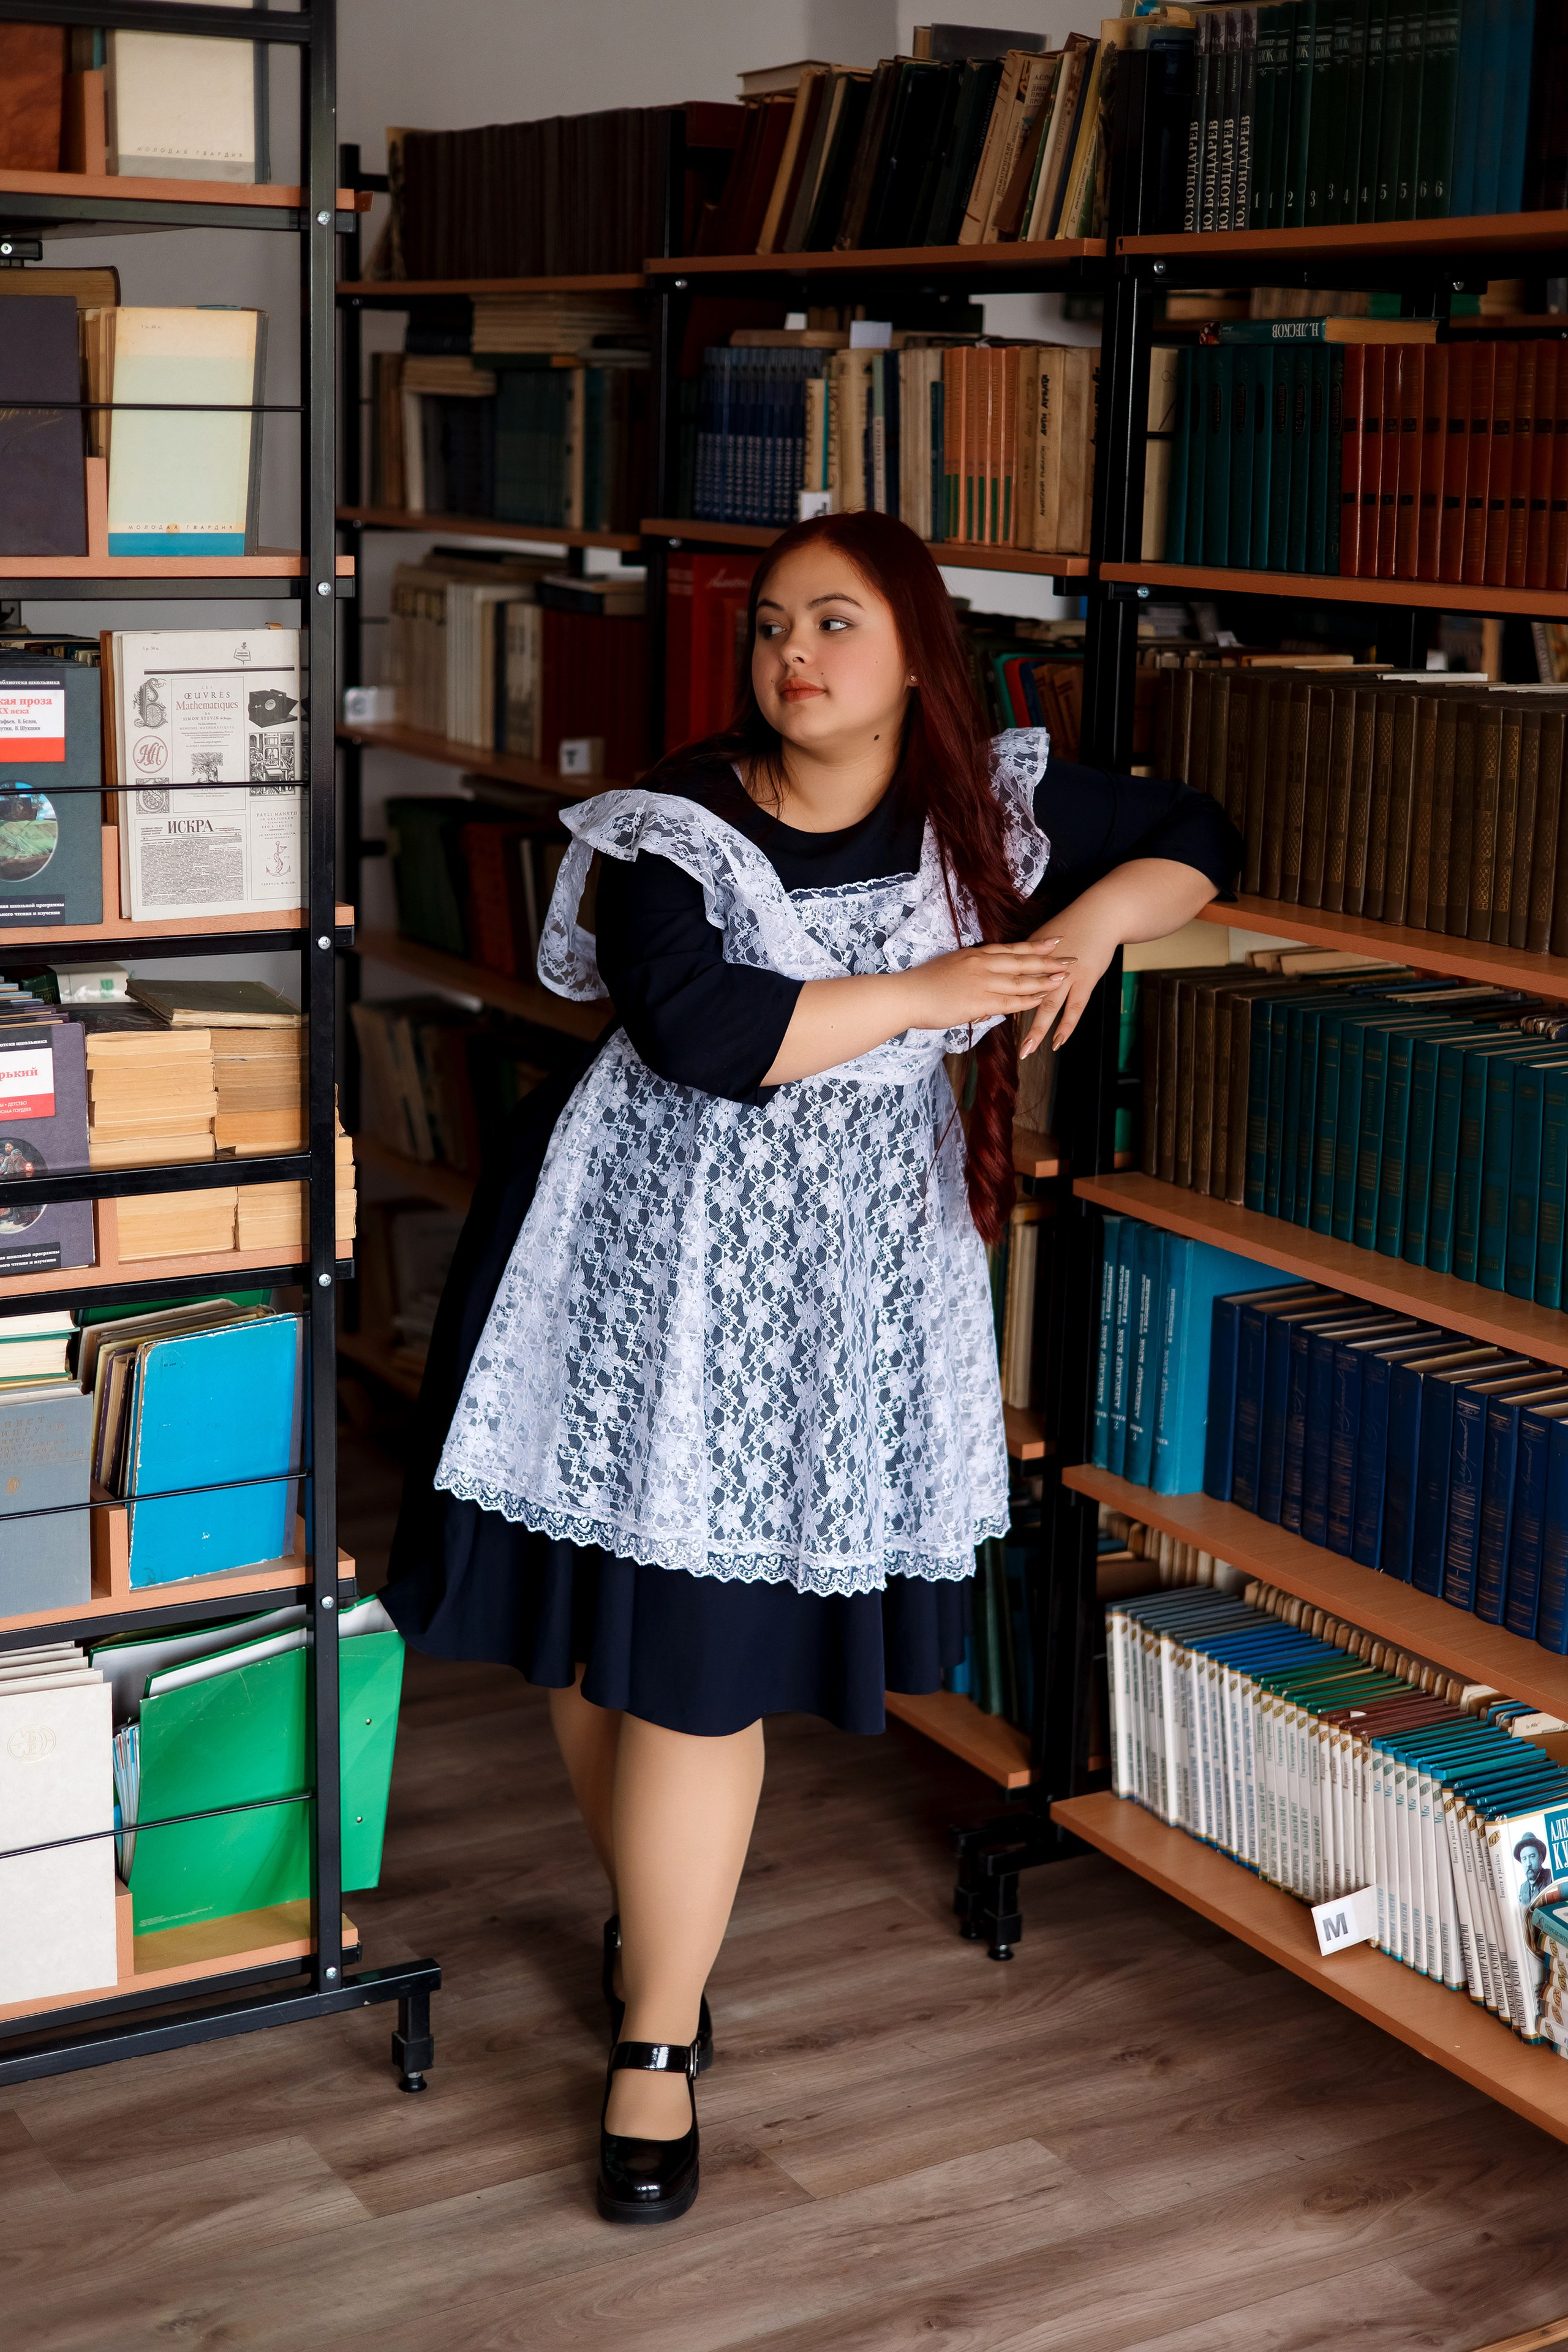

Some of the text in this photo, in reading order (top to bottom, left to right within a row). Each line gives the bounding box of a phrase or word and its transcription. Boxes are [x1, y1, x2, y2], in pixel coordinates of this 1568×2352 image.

[1257, 48, 1274, 63] БЛОК
[1315, 44, 1332, 59] БЛОК
[1183, 121, 1199, 232] Ю. БОНДАРЕВ
[1202, 120, 1219, 231] Ю. БОНДАРЕВ
[1218, 118, 1235, 231] Ю. БОНДАРЕВ
[1235, 115, 1251, 228] Ю. БОНДАРЕВ
[1328, 183, 1334, 200] 3
[1343, 189, 1349, 204] 4
[1361, 187, 1368, 202] 4
[1380, 184, 1387, 200] 5
[1400, 183, 1408, 198] 5
[1420, 181, 1427, 198] 6
[1435, 181, 1442, 198] 6
[1254, 192, 1259, 208] 1
[1269, 192, 1273, 208] 1
[1287, 191, 1294, 207] 2
[1310, 190, 1316, 207] 3
[1272, 322, 1319, 339] Н. ЛЕСКОВ
[20, 698, 52, 707] проза
[176, 700, 238, 711] Mathematiques
[167, 820, 214, 834] ИСКРА
[1097, 1351, 1107, 1404] АЛЕКСАНДР
[1114, 1355, 1123, 1409] АЛЕКСАНДР
[1134, 1365, 1144, 1419] АЛЕКСАНДР
[1374, 1781, 1381, 1792] Мы
[1385, 1785, 1393, 1798] Мы
[1396, 1794, 1404, 1806] Мы
[1409, 1799, 1417, 1811] Мы
[1422, 1806, 1430, 1818] Мы
[1434, 1812, 1443, 1823] Мы
[1463, 1829, 1471, 1849] рассказы
[1495, 1853, 1504, 1874] рассказы
[1322, 1912, 1348, 1941] М
[1460, 1923, 1476, 1992] АЛЕКСАНДР КУПРИН
[1476, 1933, 1492, 2002] АЛЕКСАНДР КУПРИН
[1488, 1943, 1506, 2012] АЛЕКСАНДР КУПРИН
[1500, 1951, 1517, 2021] АЛЕКСАНДР КУПРИН
[1510, 1960, 1527, 2029] АЛЕКСАНДР КУПРИН
